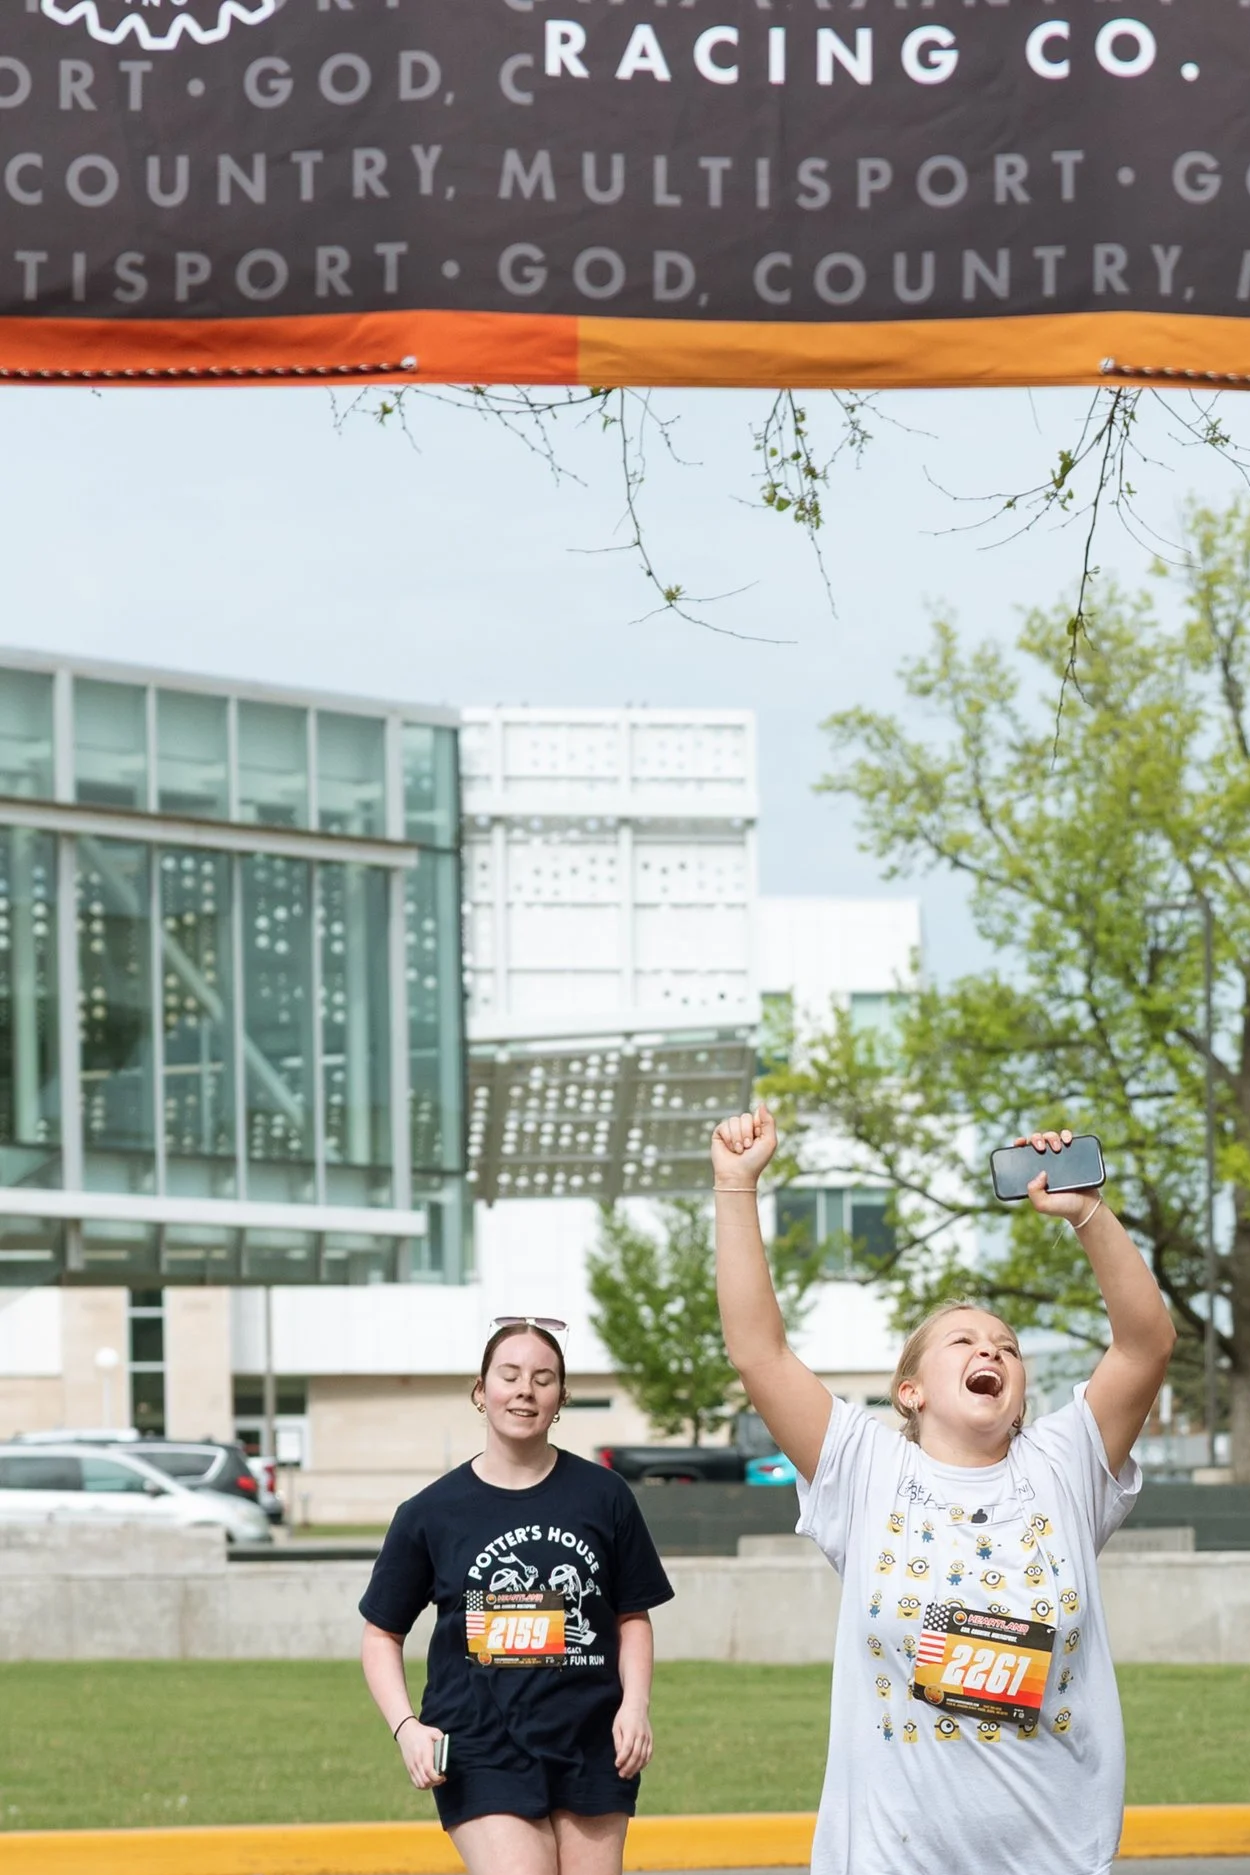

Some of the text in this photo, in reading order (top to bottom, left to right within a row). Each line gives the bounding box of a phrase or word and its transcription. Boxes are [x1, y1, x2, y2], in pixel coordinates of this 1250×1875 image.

[544, 20, 958, 84] RACING
[1025, 18, 1200, 82] CO.
[244, 51, 457, 109] GOD,
[5, 145, 456, 206] COUNTRY,
[499, 149, 1084, 209] MULTISPORT
[15, 243, 407, 303] TISPORT
[497, 243, 709, 306] GOD,
[754, 242, 1194, 305] COUNTRY,
[468, 1525, 600, 1580] POTTER'S HOUSE
[486, 1616, 550, 1650] 2159
[570, 1655, 587, 1666] FUN
[589, 1655, 605, 1666] RUN
[940, 1644, 1032, 1697] 2261
